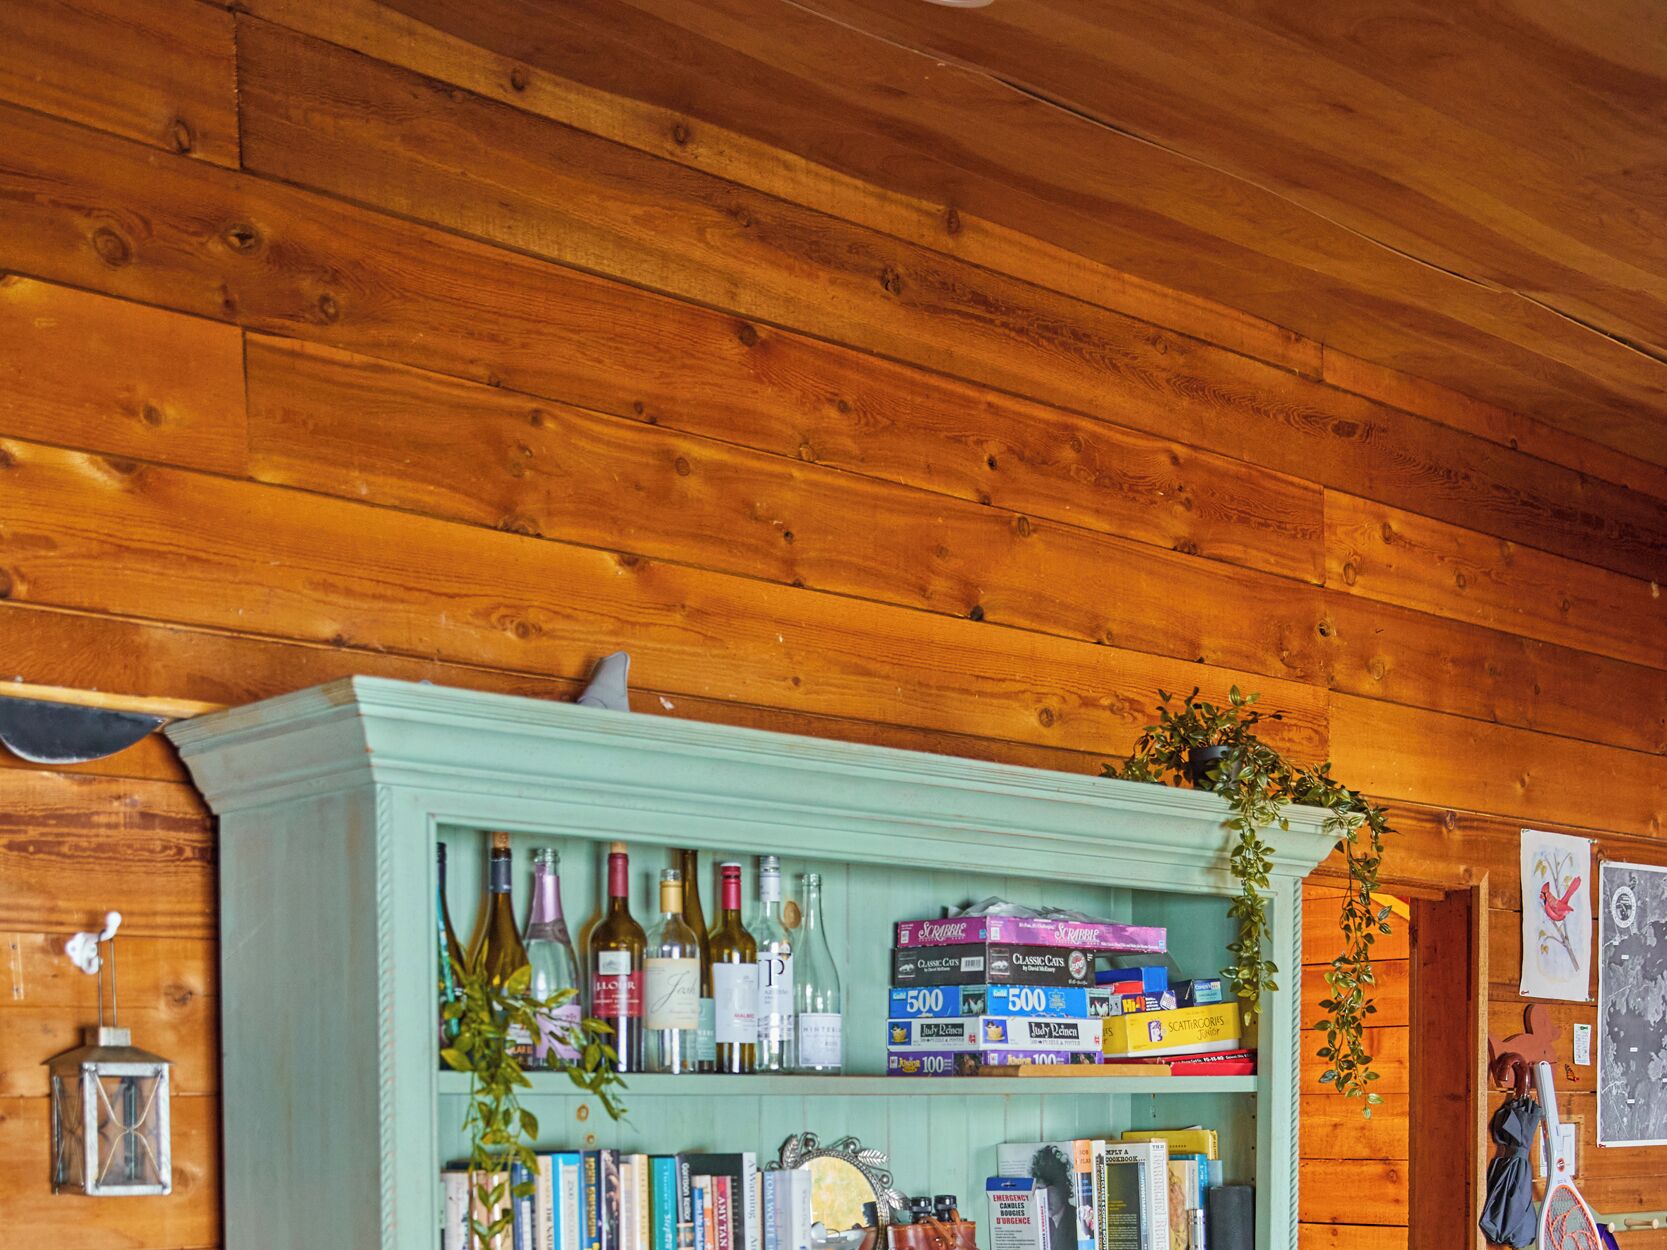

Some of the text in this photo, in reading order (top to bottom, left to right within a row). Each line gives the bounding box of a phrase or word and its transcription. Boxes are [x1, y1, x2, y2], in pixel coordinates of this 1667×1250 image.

[918, 921, 966, 941] SCRABBLE
[1055, 923, 1099, 943] SCRABBLE
[917, 957, 959, 968] CLASSIC CATS
[1012, 953, 1064, 967] CLASSIC CATS
[906, 988, 944, 1013] 500
[1008, 988, 1046, 1011] 500
[922, 1024, 938, 1037] Judy
[1031, 1023, 1050, 1038] Judy
[921, 1056, 944, 1073] 100
[747, 1172, 757, 1219] Warning
[993, 1194, 1029, 1202] EMERGENCY
[766, 1174, 776, 1238] TOM WOLFE
[718, 1196, 729, 1247] AMY TAN
[996, 1217, 1031, 1225] D'URGENCE
